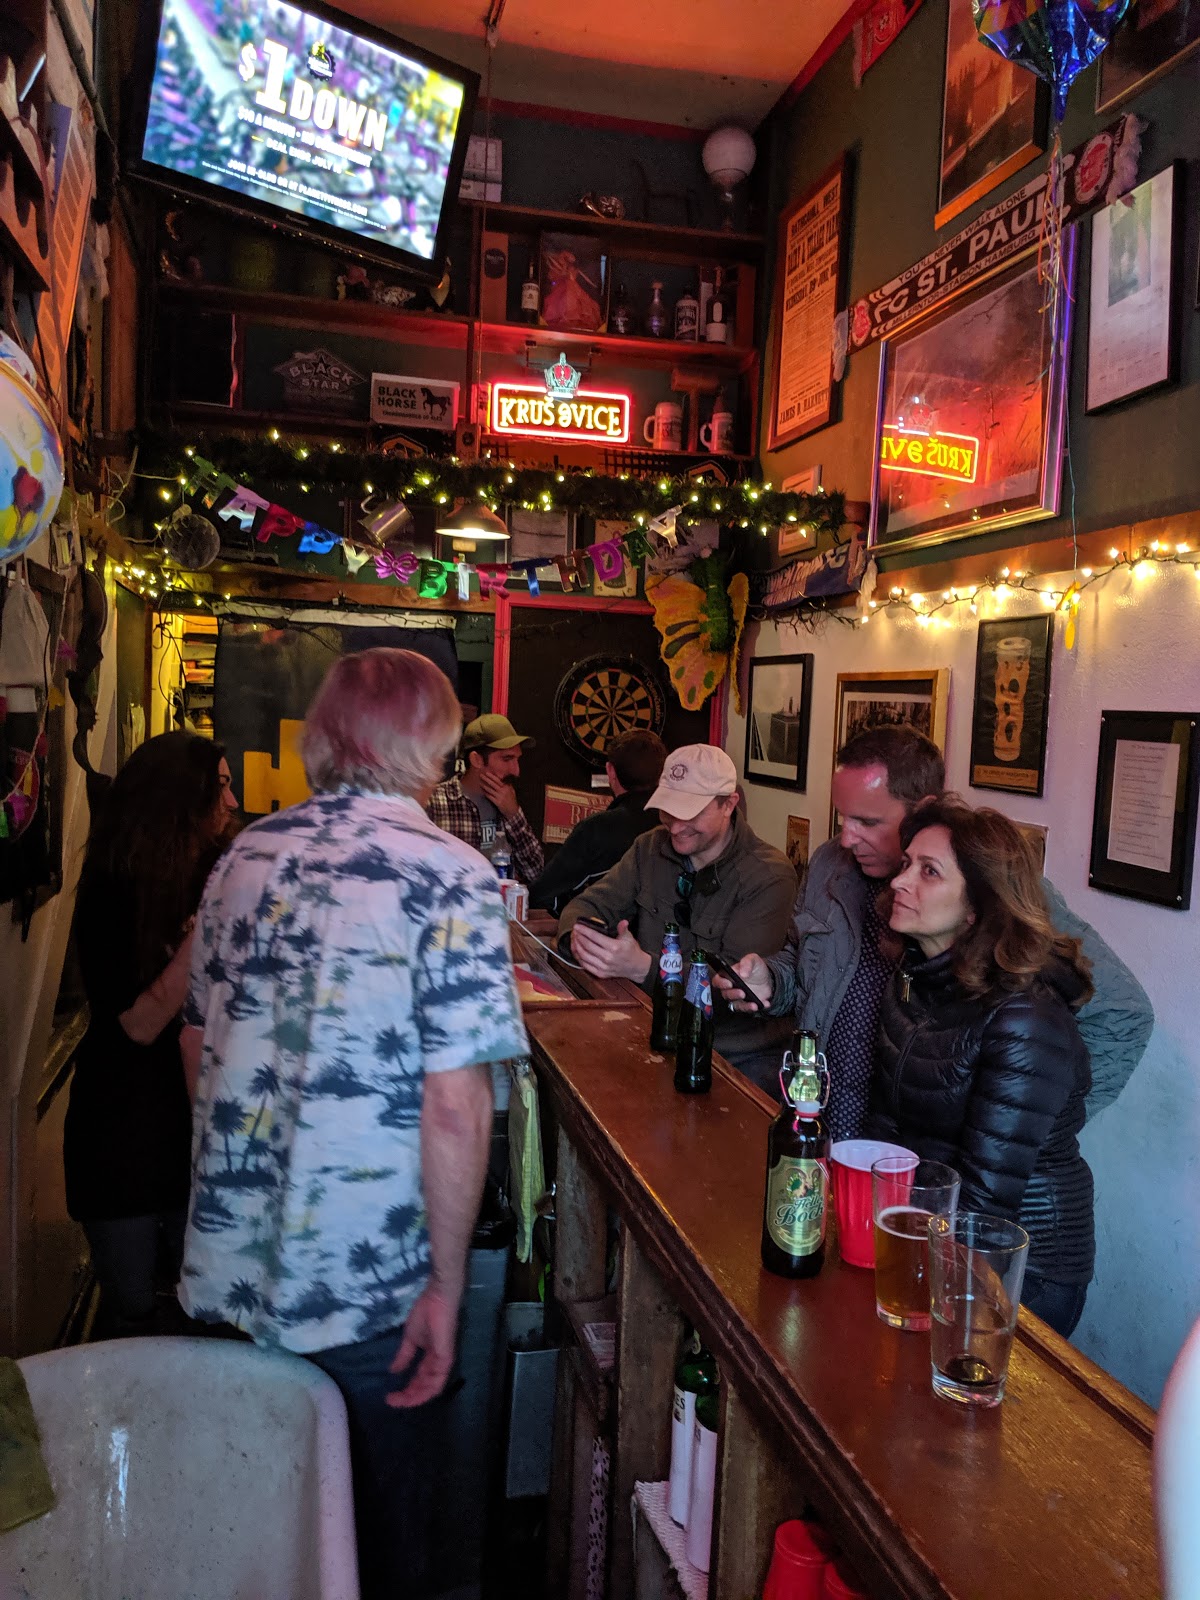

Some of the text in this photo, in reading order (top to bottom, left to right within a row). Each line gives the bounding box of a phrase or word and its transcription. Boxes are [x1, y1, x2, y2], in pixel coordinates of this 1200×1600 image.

[290, 78, 388, 152] DOWN
[266, 137, 288, 154] DEAL
[289, 145, 311, 162] ENDS
[312, 153, 334, 171] JULY
[899, 189, 1027, 284] YOU'LL NEVER WALK ALONE
[984, 229, 1037, 267] HAMBURG
[874, 286, 909, 325] FC
[917, 254, 958, 298] ST.
[290, 362, 353, 386] BLACK
[301, 378, 340, 390] STAR
[378, 386, 416, 398] BLACK
[378, 397, 417, 409] HORSE
[779, 404, 795, 425] JAMES
[188, 455, 377, 577] HAPPY
[419, 505, 681, 601] BIRTHDAY
[774, 1201, 824, 1226] Bock
